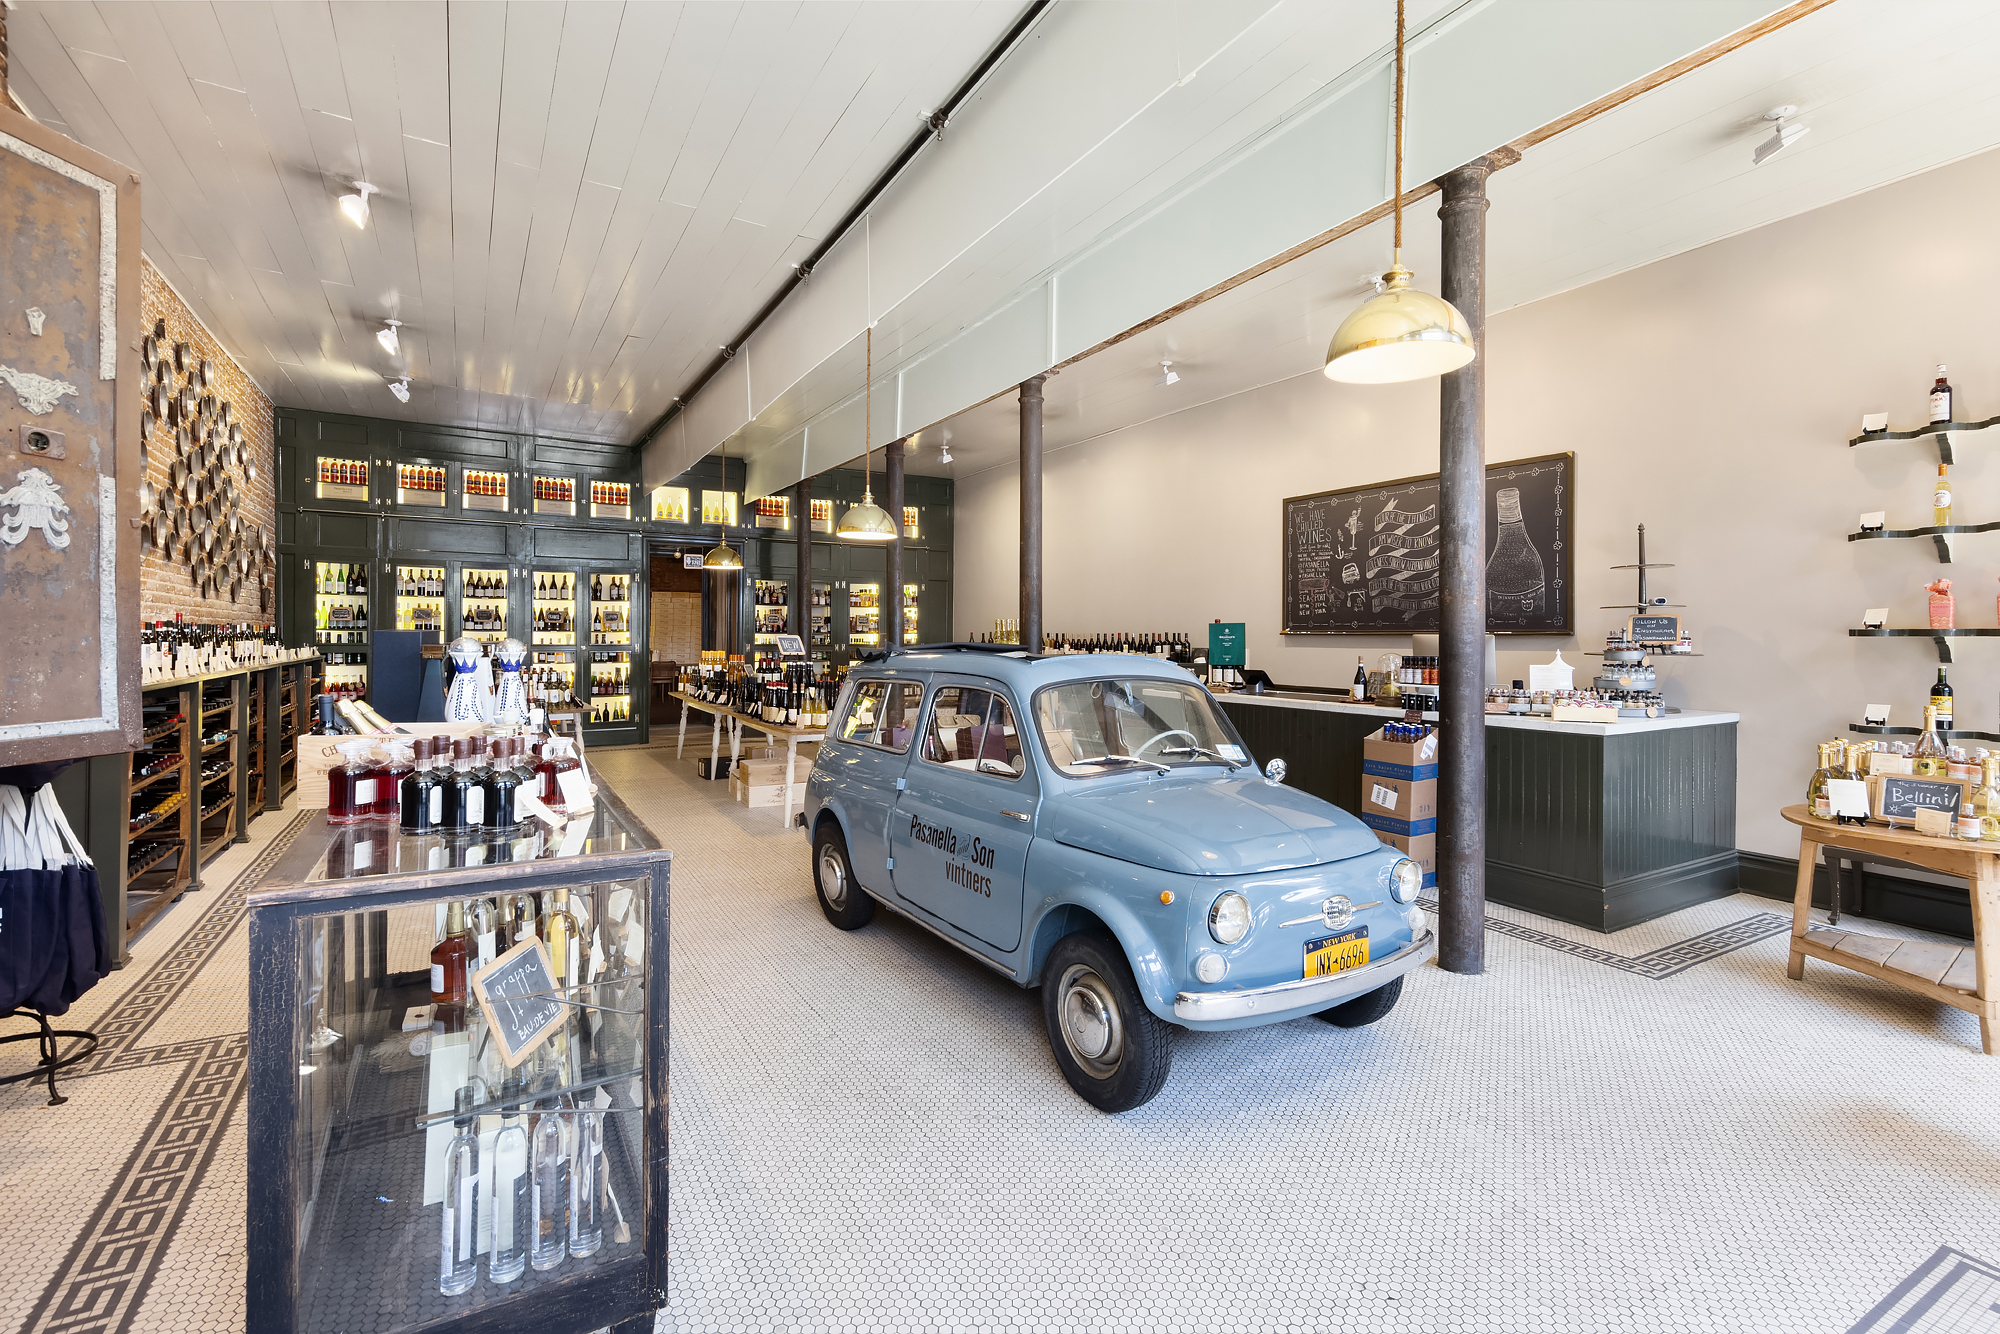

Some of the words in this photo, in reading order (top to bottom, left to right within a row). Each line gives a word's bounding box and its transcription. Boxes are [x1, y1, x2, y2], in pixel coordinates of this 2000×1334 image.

[1294, 512, 1304, 523] WE
[1310, 509, 1326, 521] HAVE
[1296, 519, 1323, 533] CHILLED
[1297, 528, 1332, 544] WINES
[1299, 594, 1310, 602] SEA
[1314, 593, 1326, 602] PORT
[781, 639, 799, 650] NEW
[909, 813, 957, 855] Pasanella
[971, 836, 995, 870] Son
[945, 857, 992, 898] vintners
[1322, 937, 1340, 948] NEW
[1340, 932, 1356, 943] YORK
[494, 963, 538, 1030] grappa
